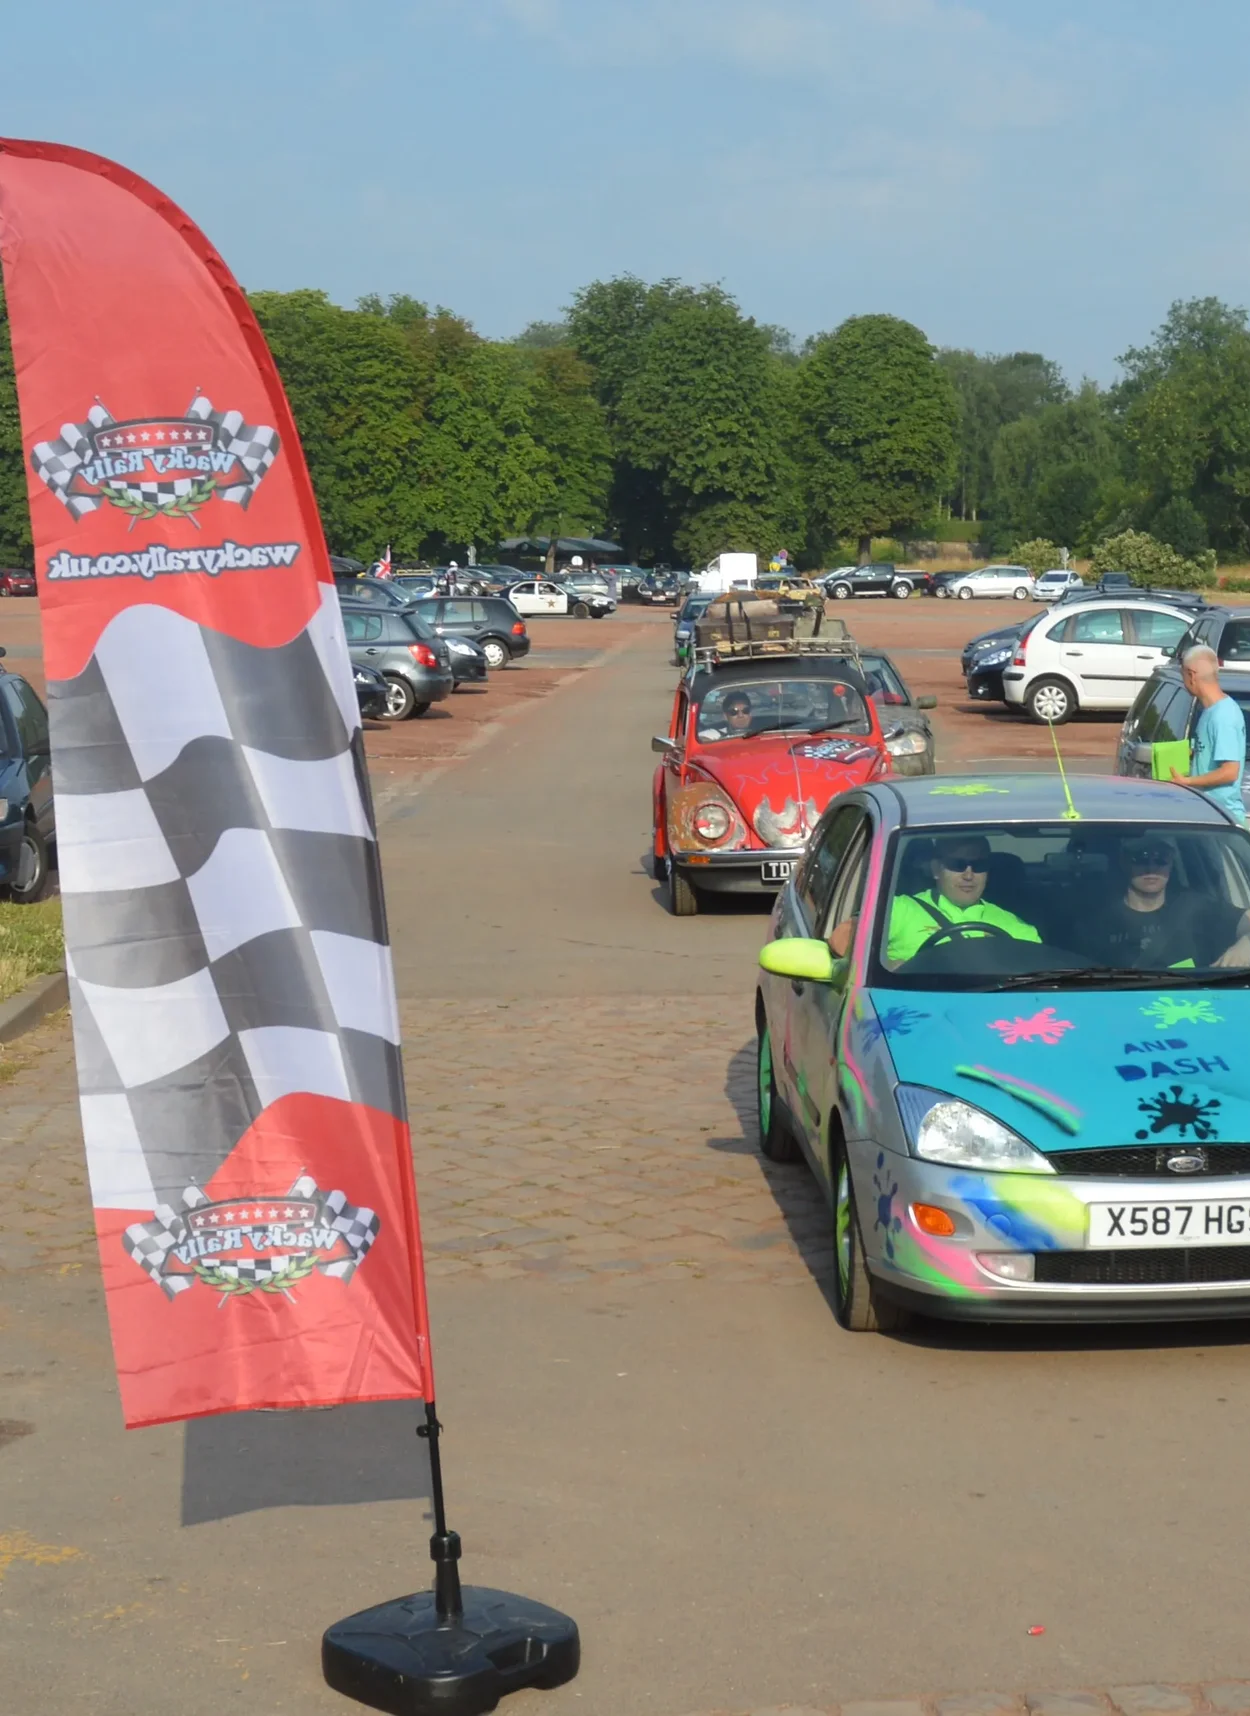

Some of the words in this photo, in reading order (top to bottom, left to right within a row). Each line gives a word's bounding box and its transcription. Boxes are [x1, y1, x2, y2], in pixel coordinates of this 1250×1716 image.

[1124, 1038, 1188, 1055] AND
[1114, 1055, 1231, 1082] DASH
[1107, 1206, 1193, 1236] X587
